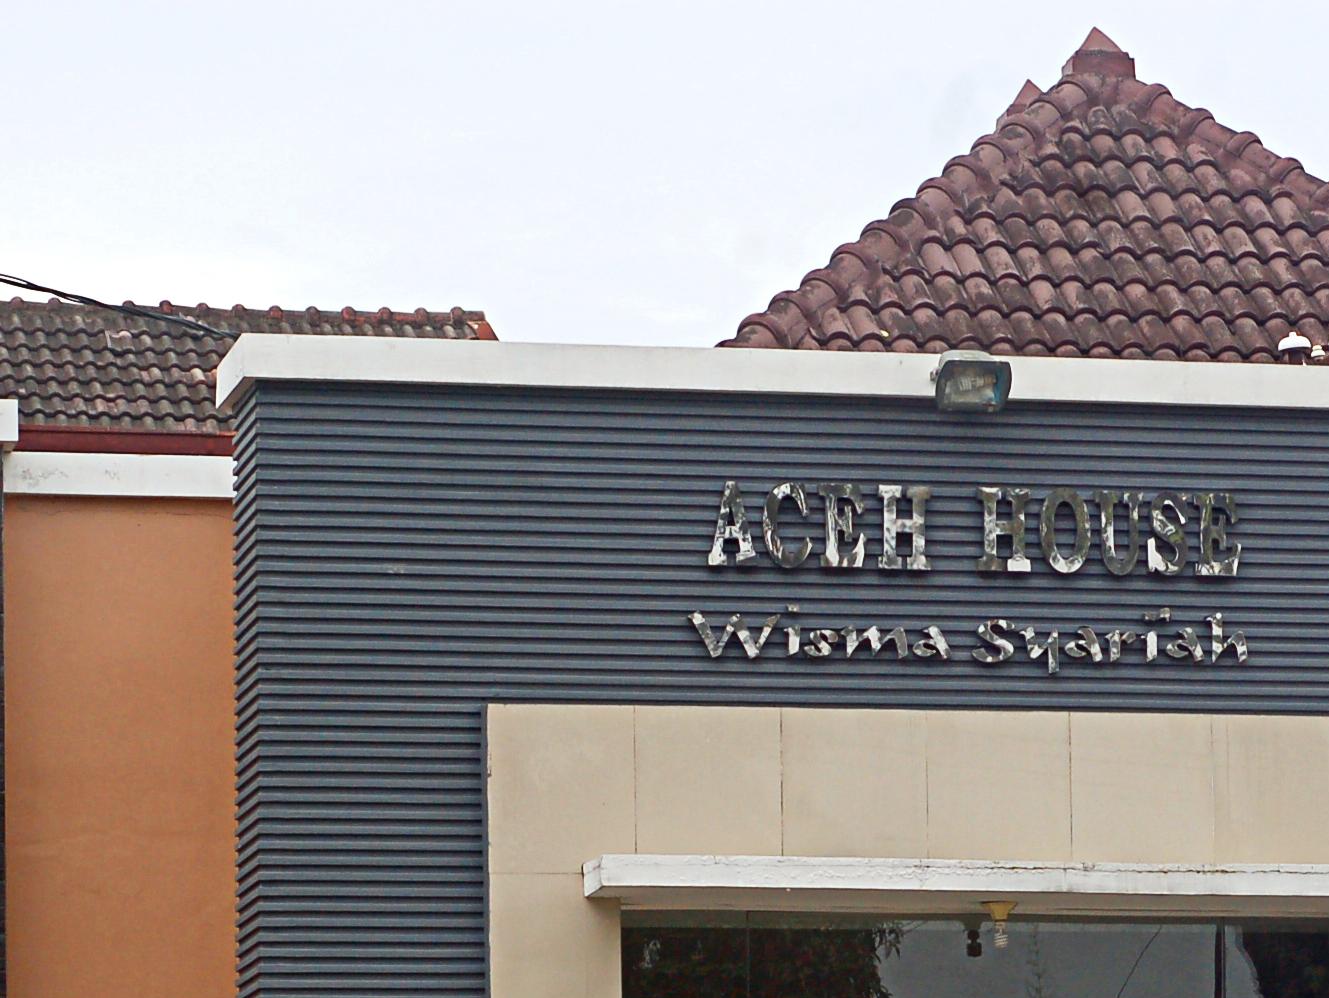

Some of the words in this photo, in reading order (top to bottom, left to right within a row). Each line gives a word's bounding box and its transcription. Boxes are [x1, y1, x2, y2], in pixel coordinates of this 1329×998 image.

[707, 481, 932, 570] ACEH
[976, 487, 1242, 576] HOUSE
[687, 604, 952, 660] Wisma
[971, 608, 1250, 675] Syariah
